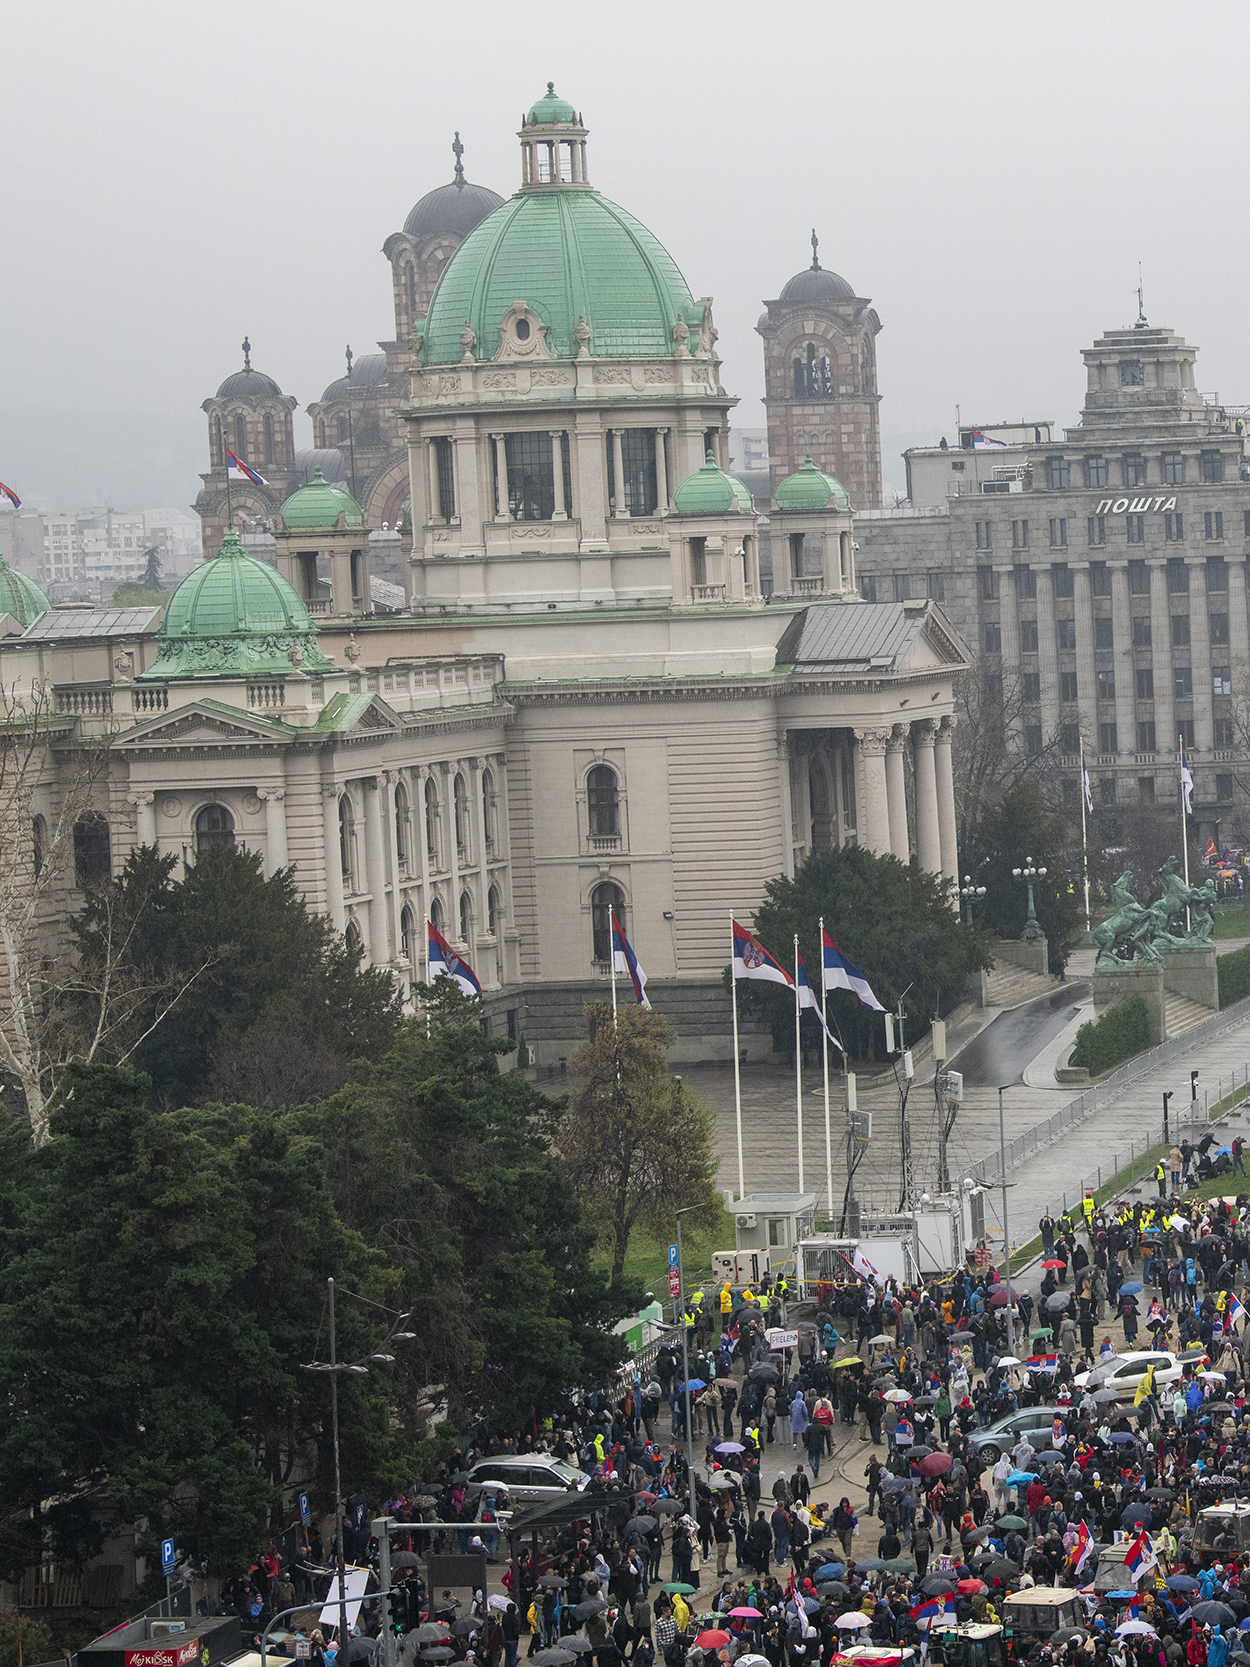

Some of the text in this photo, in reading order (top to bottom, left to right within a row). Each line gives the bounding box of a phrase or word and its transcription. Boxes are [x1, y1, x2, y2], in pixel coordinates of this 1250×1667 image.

[1095, 496, 1177, 514] ПОШТА
[670, 1247, 676, 1262] P
[301, 1496, 307, 1514] P
[164, 1542, 172, 1562] P
[130, 1653, 144, 1666] Moj
